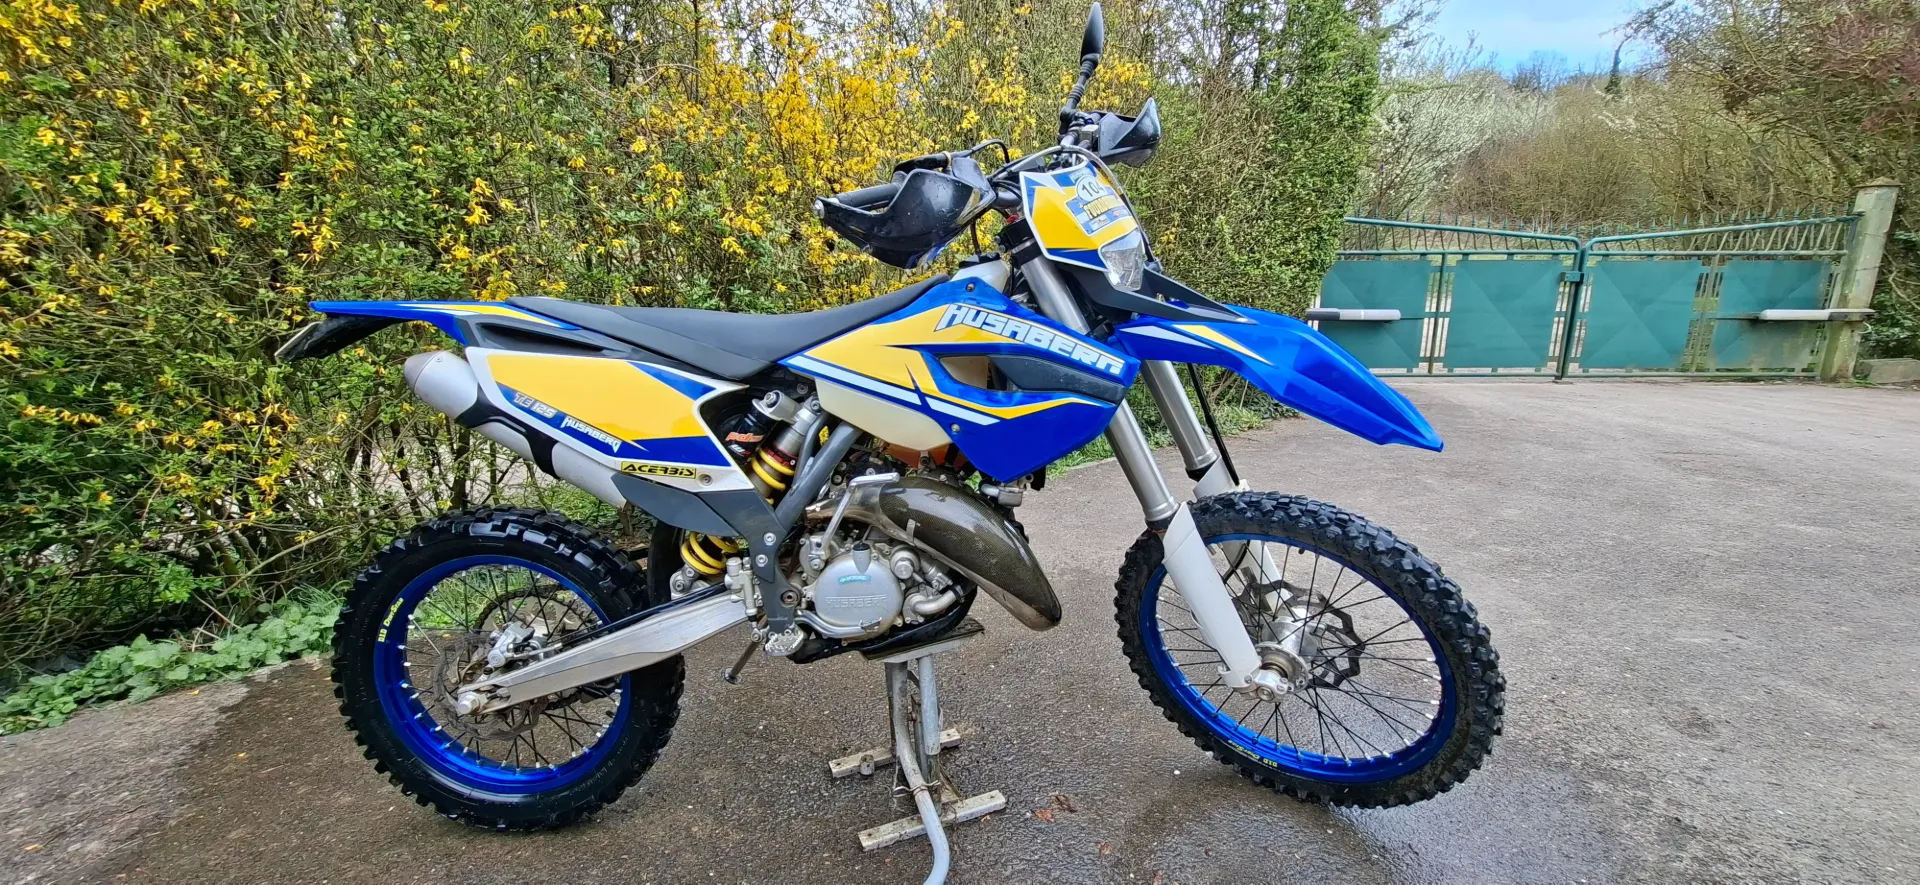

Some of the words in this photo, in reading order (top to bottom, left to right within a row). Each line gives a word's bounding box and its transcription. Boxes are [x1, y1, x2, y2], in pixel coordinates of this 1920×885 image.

[934, 303, 1125, 375] HUSABERG
[514, 392, 535, 408] TE
[533, 399, 558, 418] 125
[560, 416, 623, 453] HUSABERG
